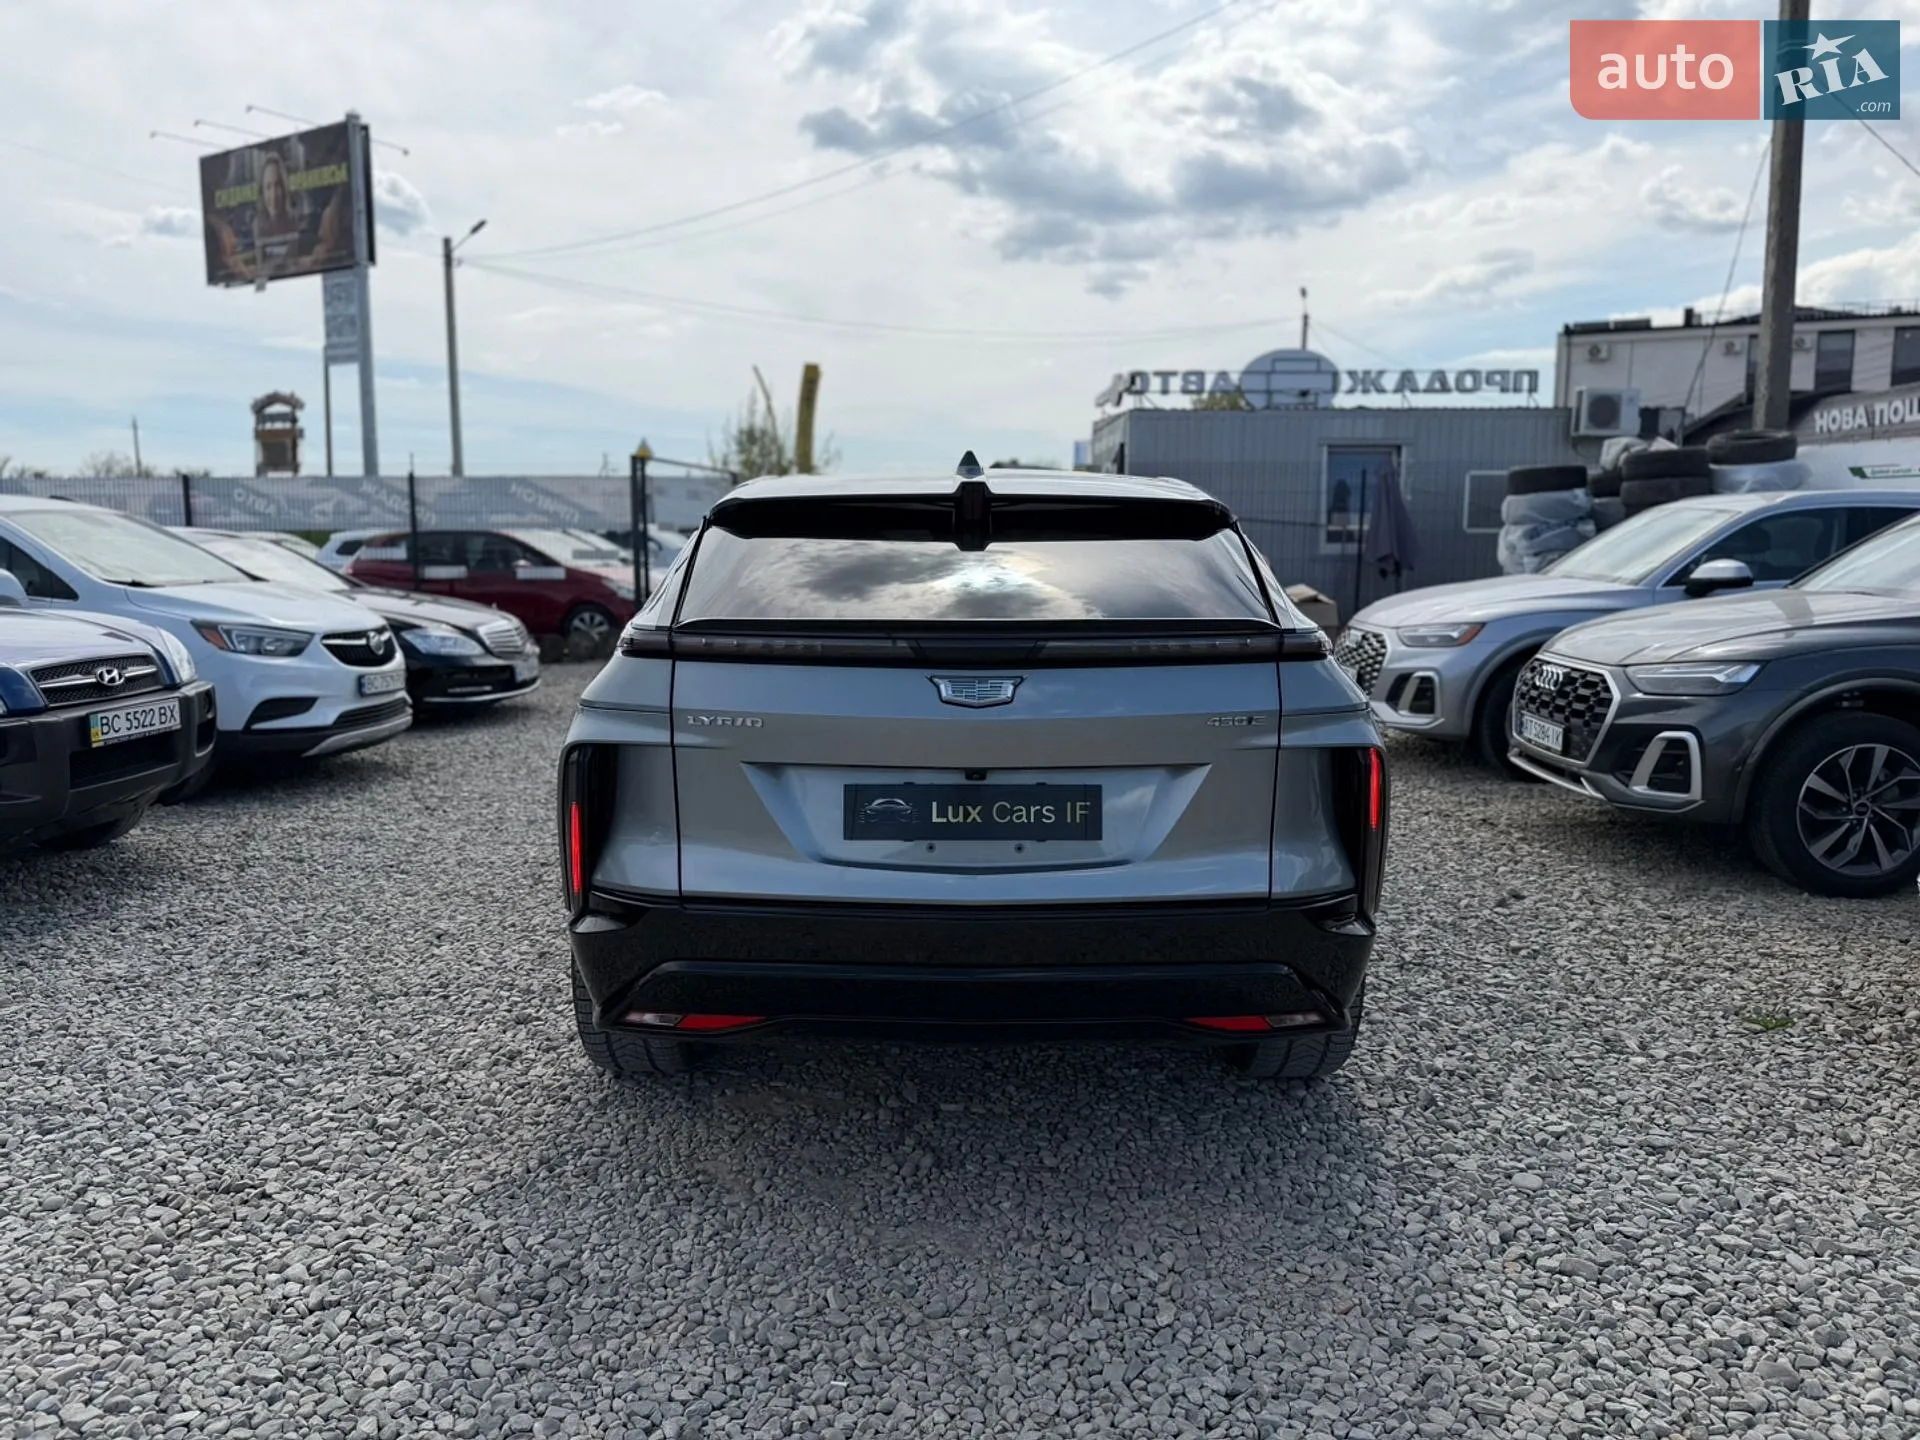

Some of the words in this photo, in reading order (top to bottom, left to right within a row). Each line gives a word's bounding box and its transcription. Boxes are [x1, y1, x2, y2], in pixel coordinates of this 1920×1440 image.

[1814, 404, 1868, 433] НОВА
[100, 714, 121, 736] BC
[125, 708, 156, 731] 5522
[158, 704, 177, 725] BX
[931, 801, 982, 823] Lux
[992, 801, 1056, 823] Cars
[1066, 801, 1091, 823] IF
